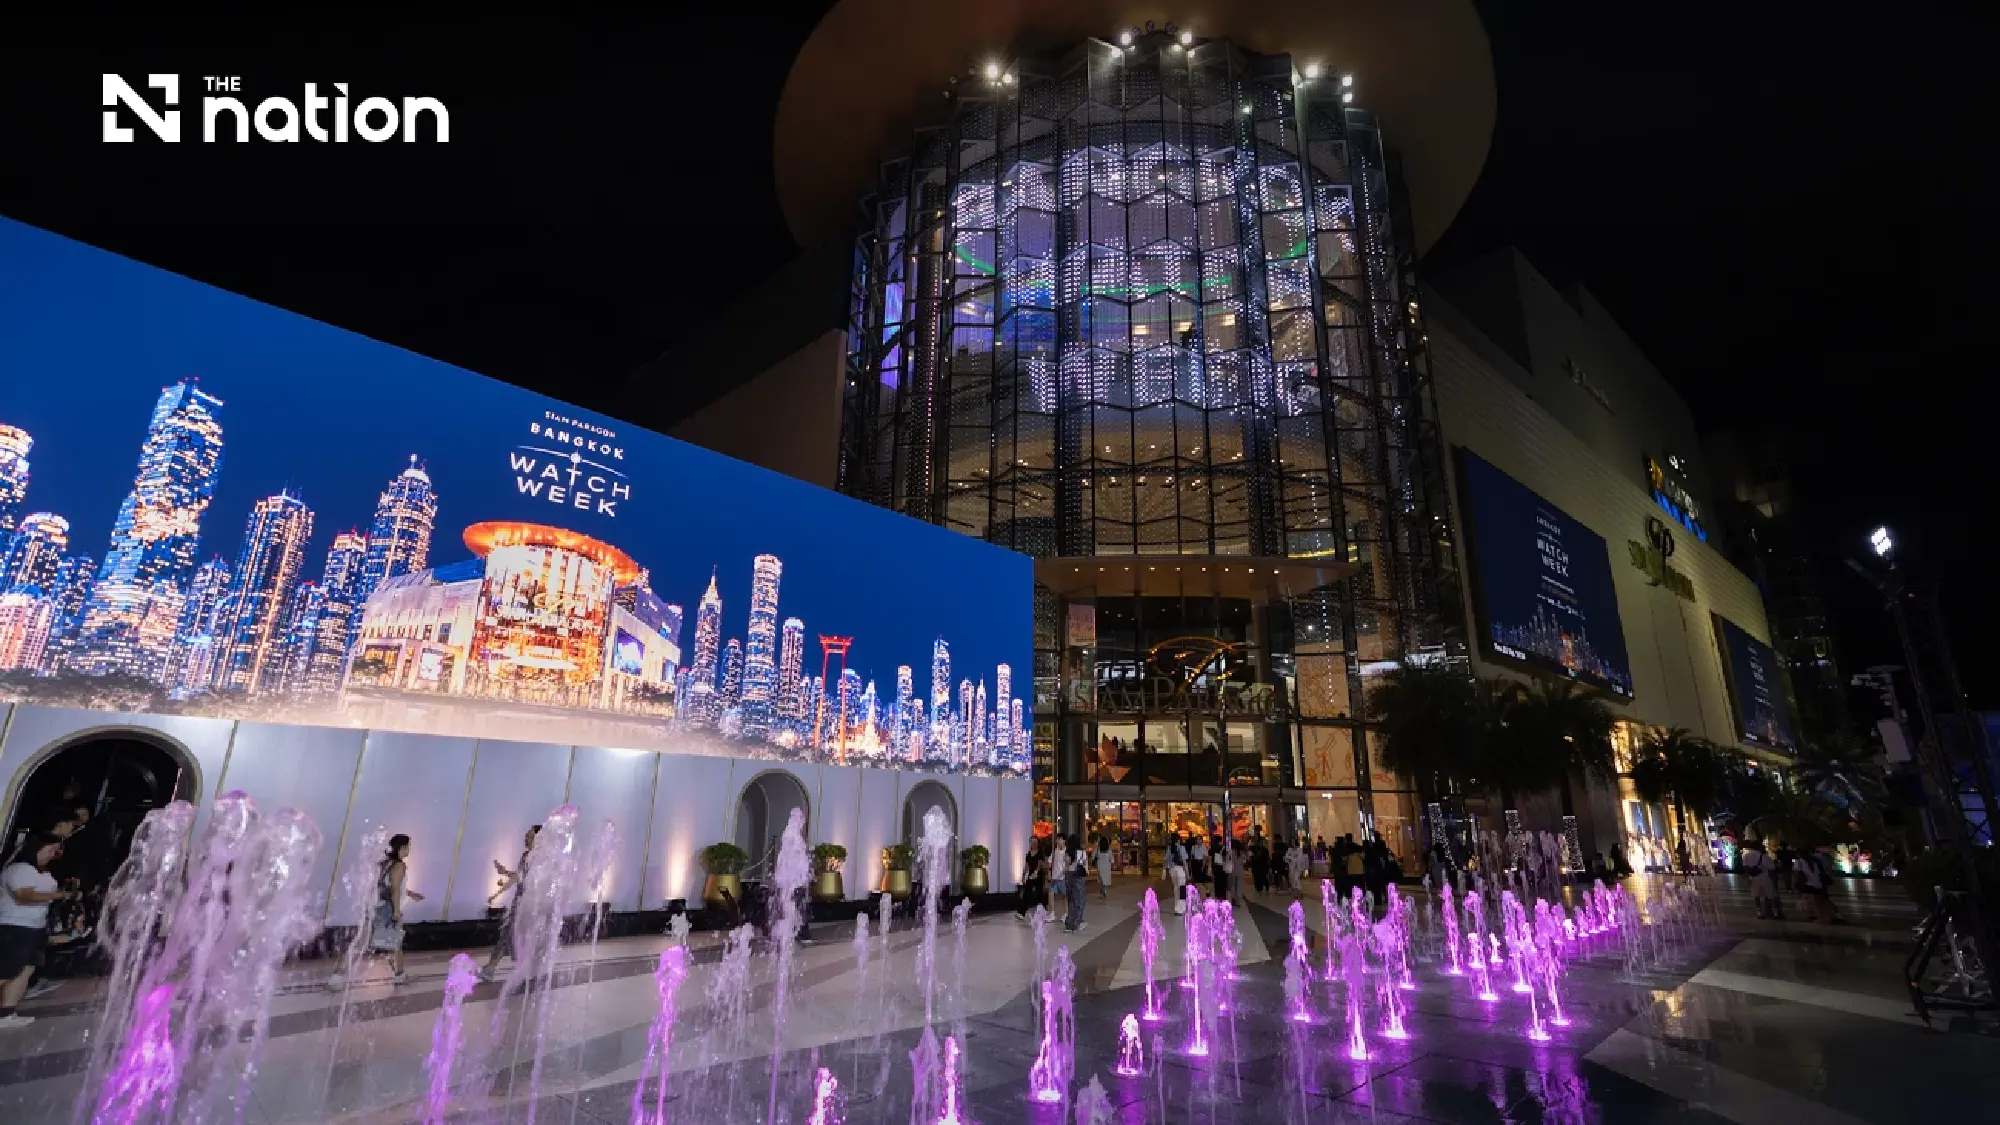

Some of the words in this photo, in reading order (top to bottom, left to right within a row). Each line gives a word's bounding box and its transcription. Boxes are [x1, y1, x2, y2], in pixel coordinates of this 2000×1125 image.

[530, 422, 624, 460] BANGKOK
[571, 419, 616, 439] PARAGON
[510, 451, 630, 500] WATCH
[516, 476, 618, 517] WEEK
[1076, 682, 1147, 715] SAM
[1151, 676, 1277, 716] PARGON
